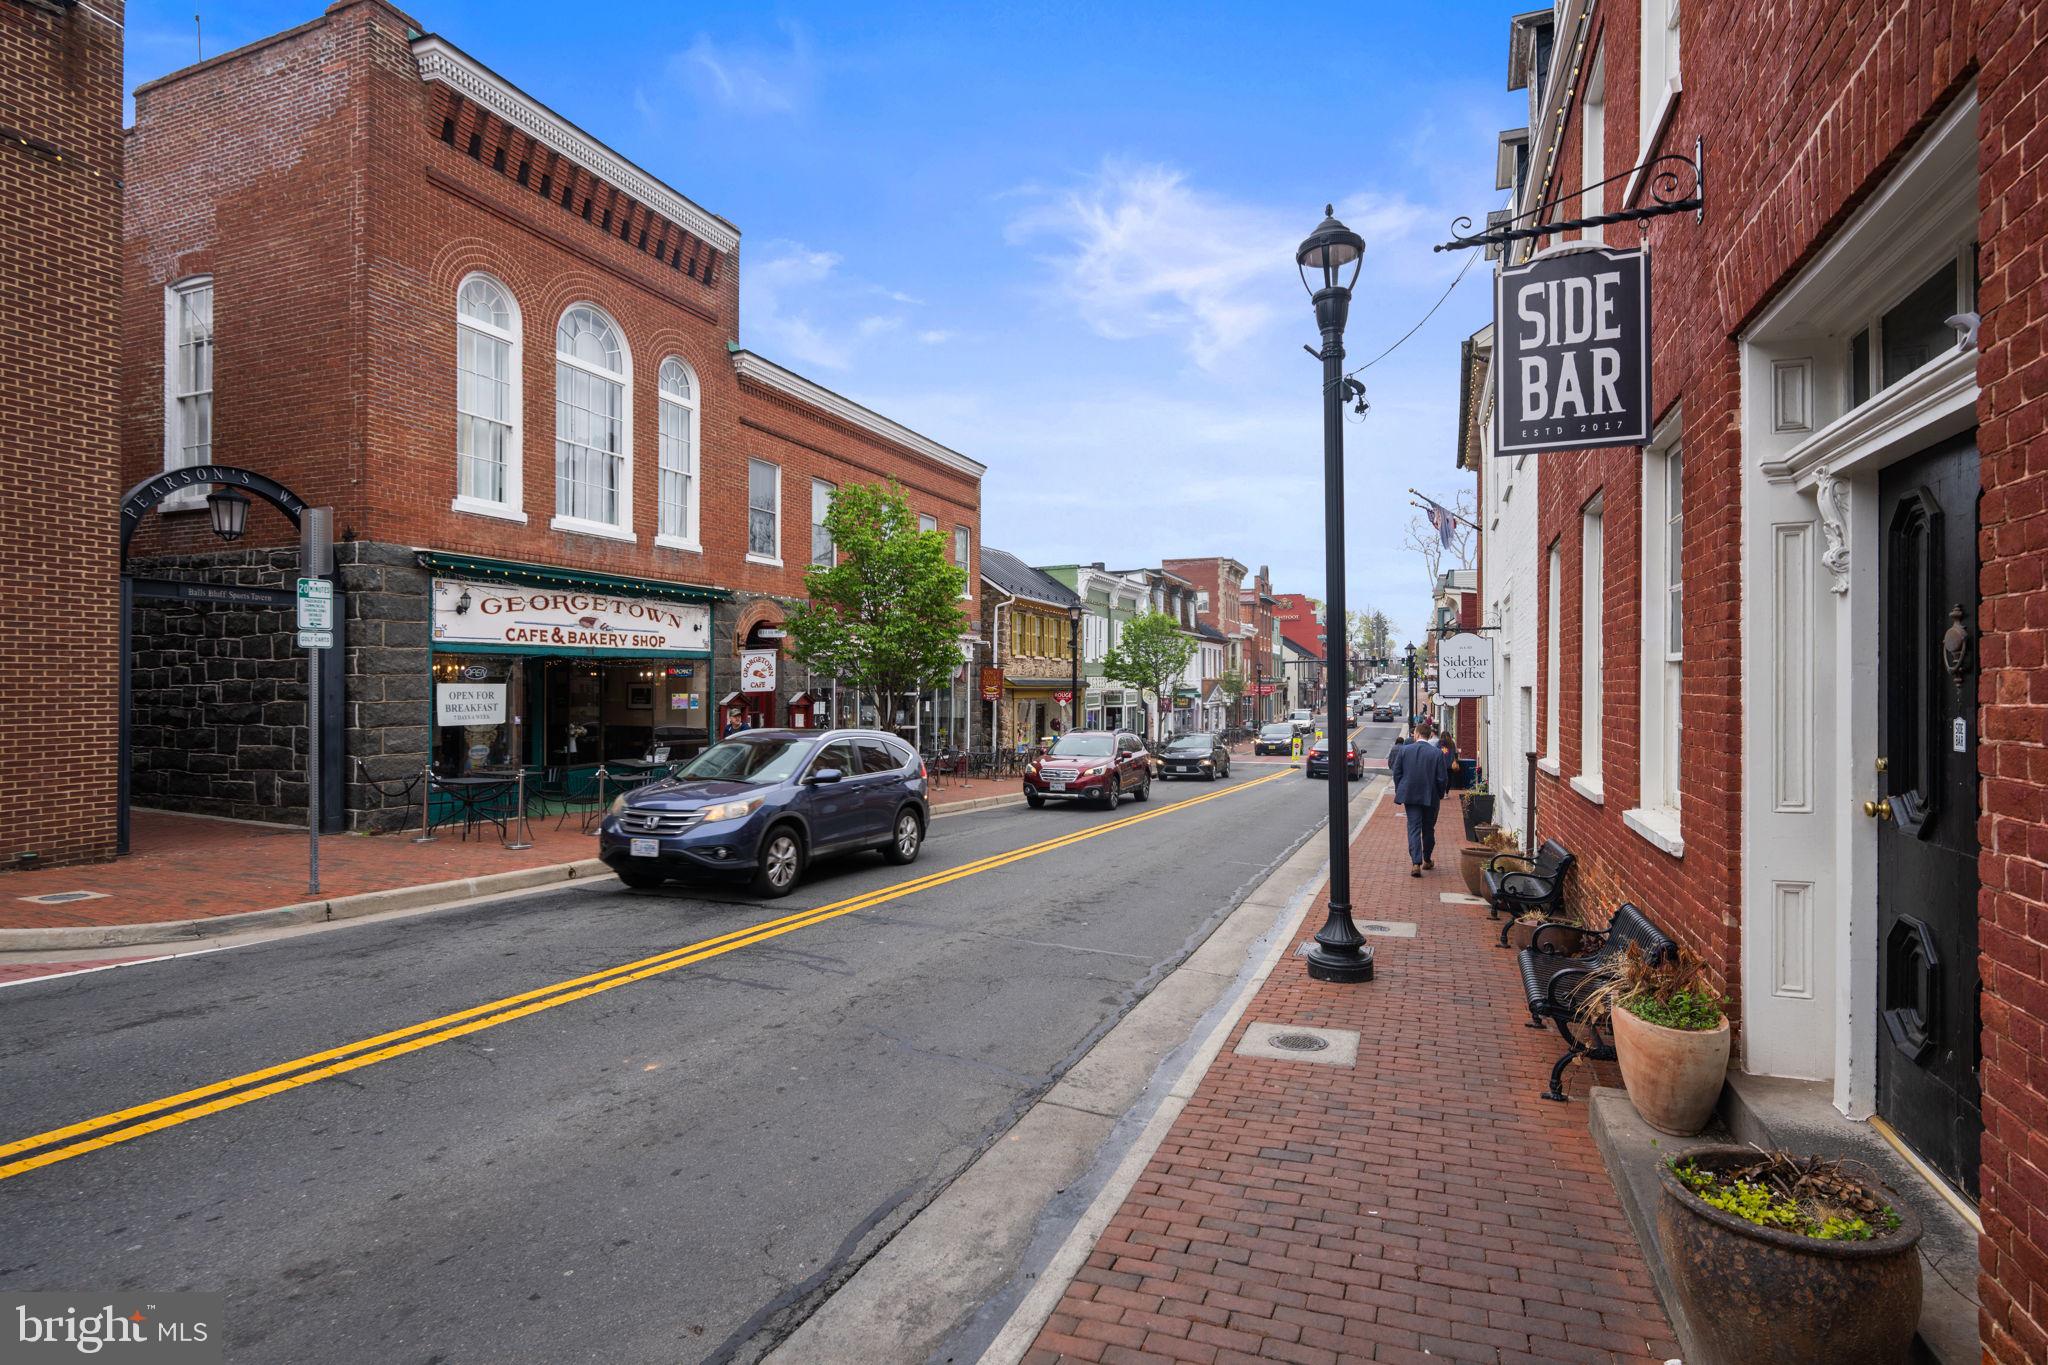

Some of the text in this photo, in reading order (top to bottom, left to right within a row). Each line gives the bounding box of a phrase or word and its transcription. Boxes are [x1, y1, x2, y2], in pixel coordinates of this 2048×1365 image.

[1517, 271, 1621, 351] SIDE
[1518, 347, 1626, 422] BAR
[1522, 421, 1623, 438] ESTD 2017
[123, 467, 303, 519] PEARSON'S WA
[299, 583, 309, 594] 20
[228, 591, 250, 600] Sports
[250, 592, 272, 601] Tavern
[480, 594, 683, 629] GEORGETOWN
[505, 626, 666, 648] CAFE & BAKERY SHOP
[743, 656, 774, 678] GEORGETOWN
[1443, 655, 1489, 667] SideBar
[465, 668, 487, 677] OPEN
[1446, 667, 1486, 679] Coffee
[449, 691, 495, 700] OPEN FOR
[445, 703, 499, 713] BREAKFAST
